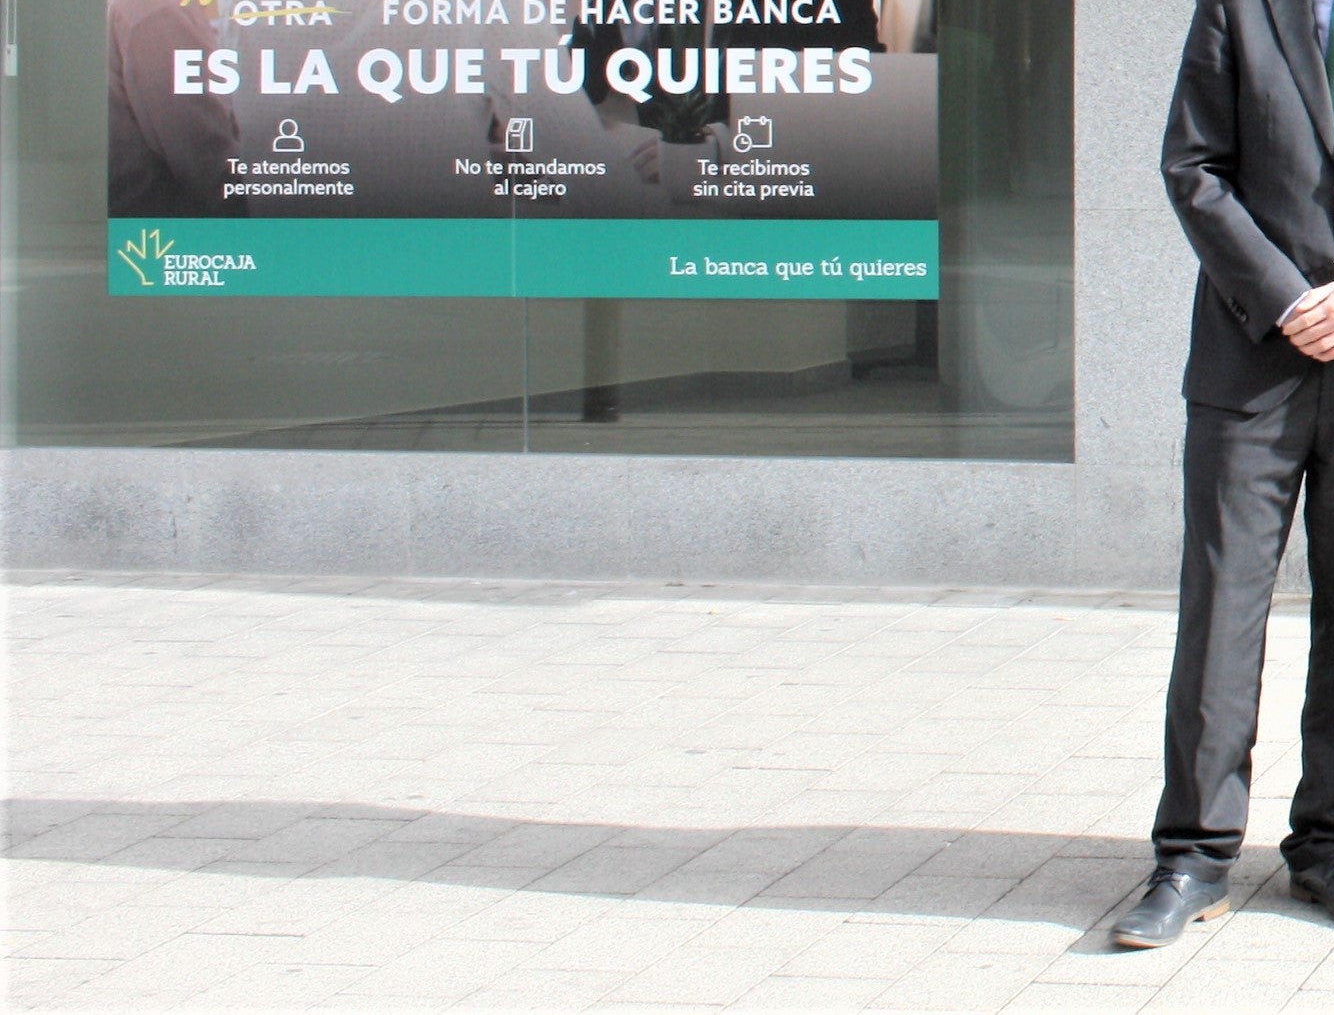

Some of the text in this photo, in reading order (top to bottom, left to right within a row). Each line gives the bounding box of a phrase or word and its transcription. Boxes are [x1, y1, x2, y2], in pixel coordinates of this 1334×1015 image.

[233, 0, 333, 26] OTRA
[173, 33, 873, 104] ES LA QUE TÚ QUIERES
[227, 158, 350, 175] Te atendemos
[455, 158, 606, 175] No te mandamos
[697, 158, 810, 176] Te recibimos
[223, 179, 354, 199] personalmente
[494, 180, 566, 200] al cajero
[693, 181, 814, 201] sin cita previa
[164, 254, 256, 270] EUROCAJA
[669, 256, 927, 281] La banca que tú quieres
[164, 271, 225, 286] RURAL
